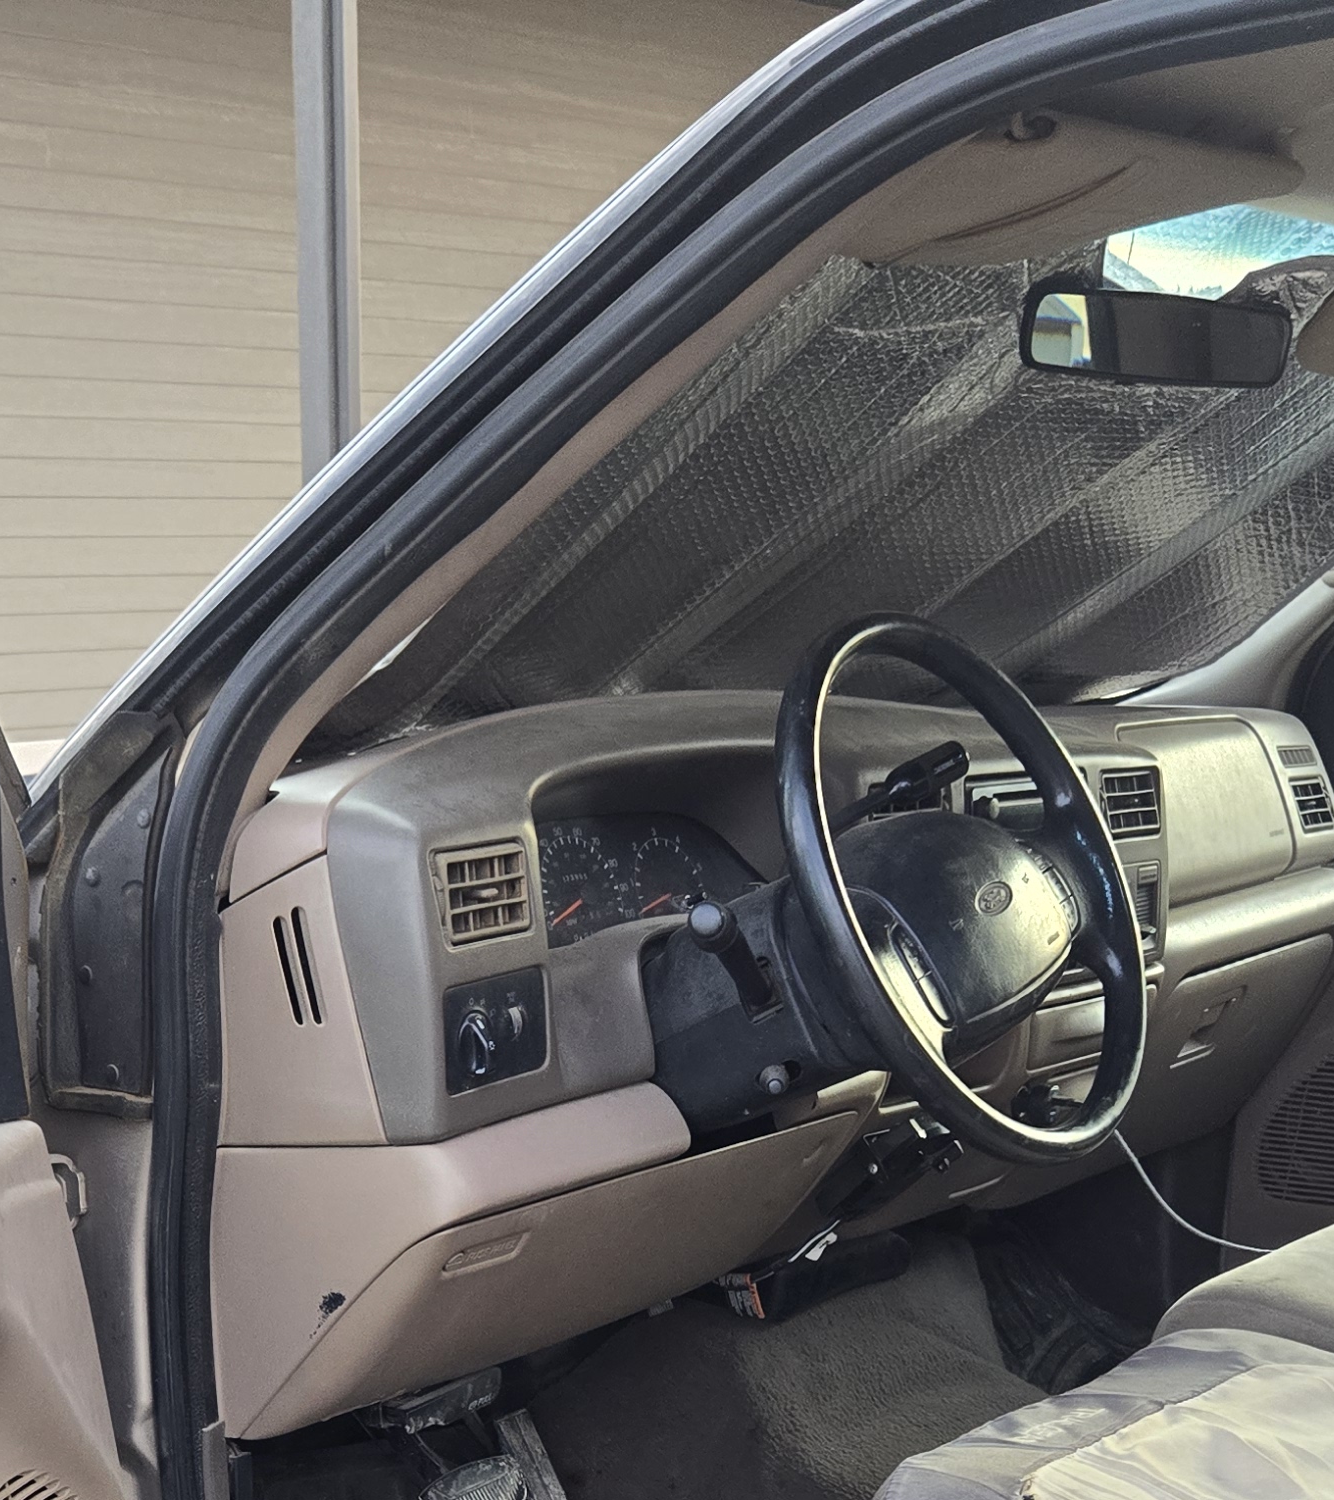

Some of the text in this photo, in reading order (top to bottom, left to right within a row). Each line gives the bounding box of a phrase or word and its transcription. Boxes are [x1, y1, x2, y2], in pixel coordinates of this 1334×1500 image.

[552, 826, 563, 837] 50
[572, 826, 583, 837] 60
[591, 837, 601, 847] 70
